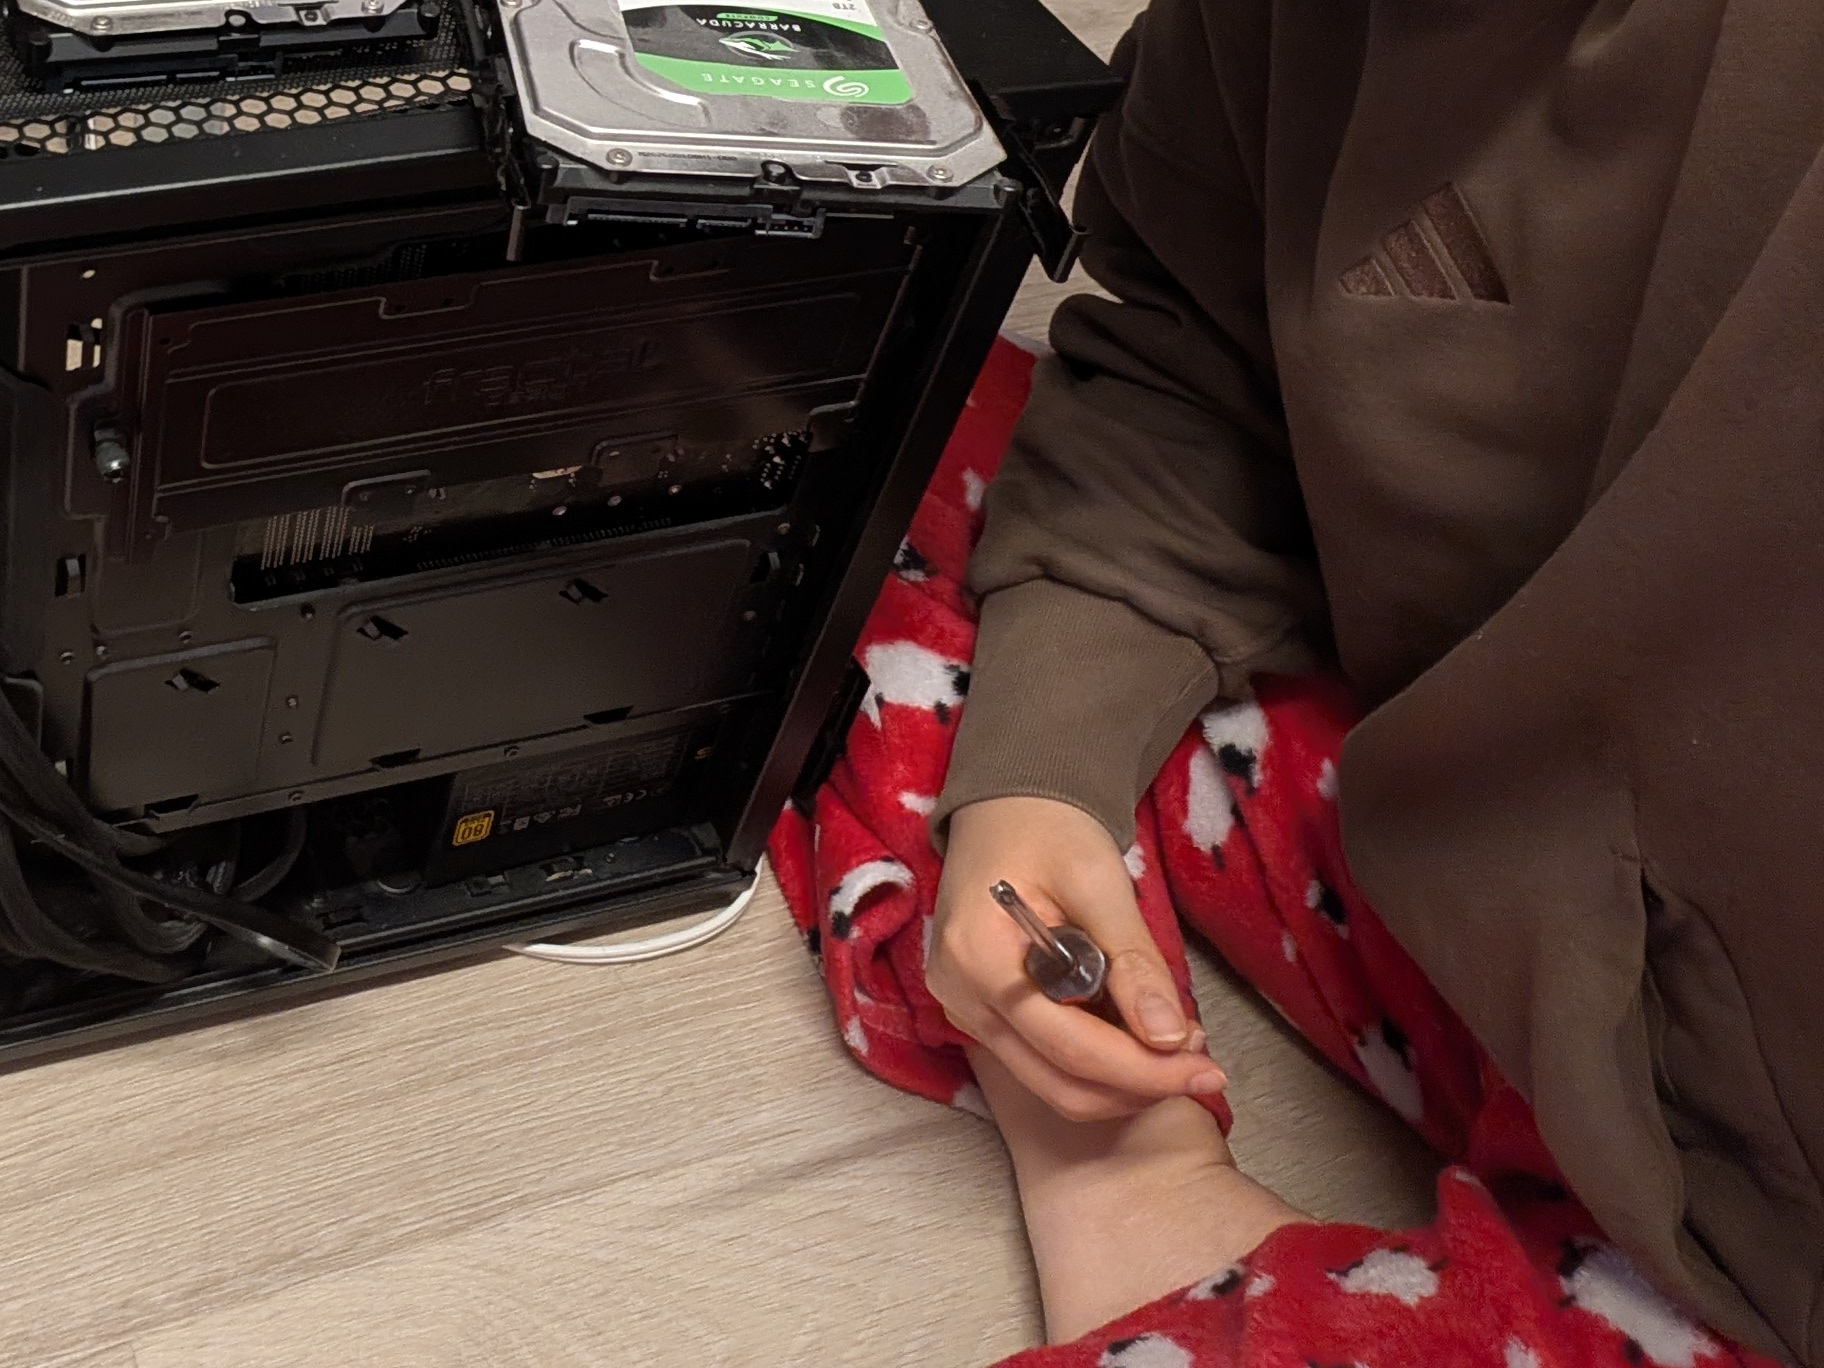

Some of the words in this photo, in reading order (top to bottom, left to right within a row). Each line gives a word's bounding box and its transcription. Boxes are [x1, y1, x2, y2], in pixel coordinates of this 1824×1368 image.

[833, 2, 857, 11] 2TB
[695, 18, 802, 32] BARRACUDA
[700, 72, 816, 89] SEAGATE
[460, 823, 485, 841] 80
